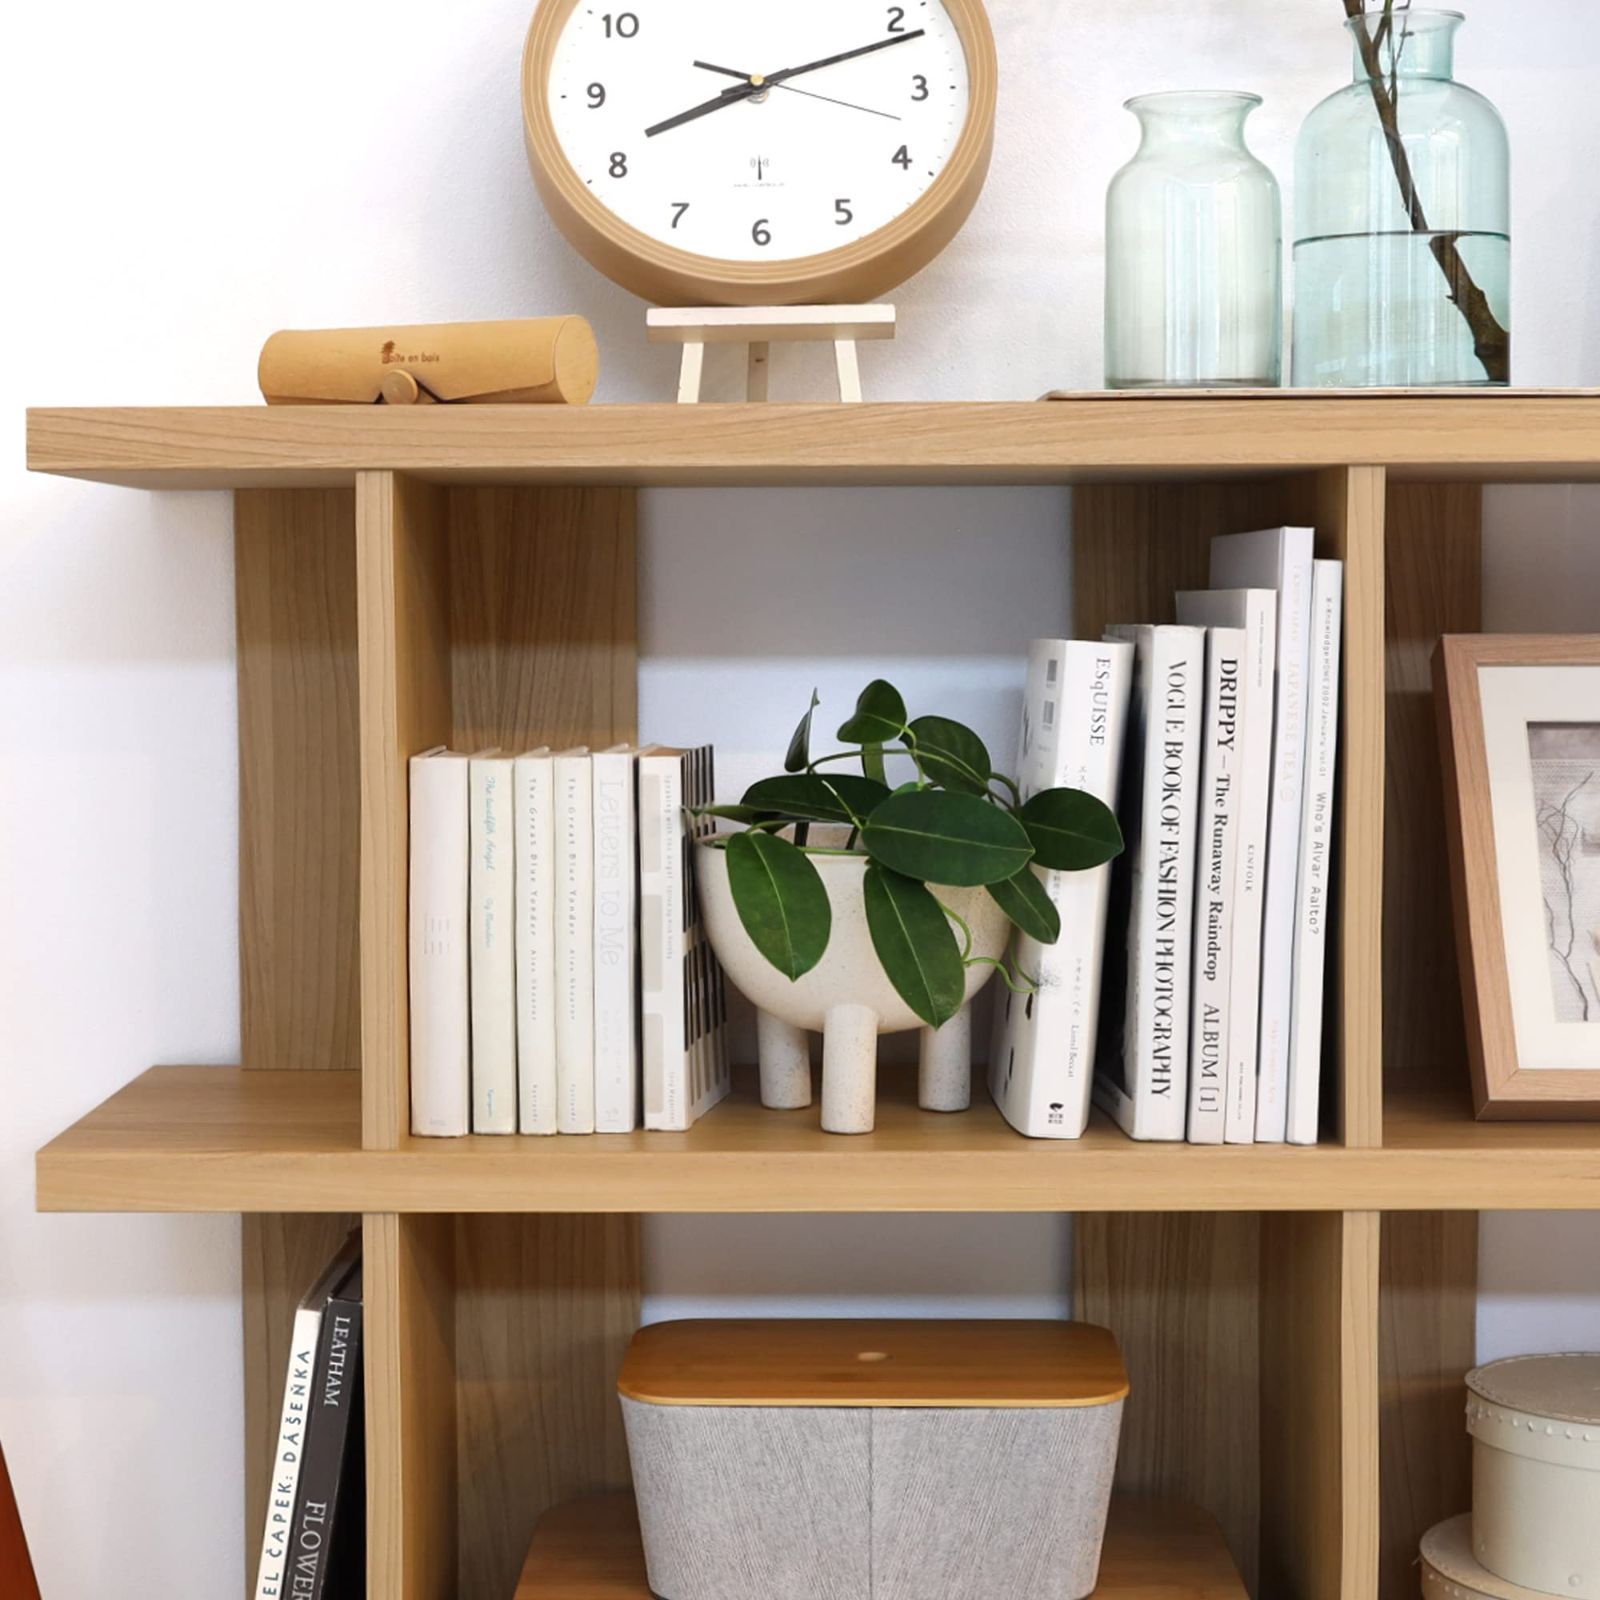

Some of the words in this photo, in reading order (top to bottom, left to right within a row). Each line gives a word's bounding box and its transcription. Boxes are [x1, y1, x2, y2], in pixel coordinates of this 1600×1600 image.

[602, 12, 640, 38] 10
[886, 7, 905, 33] 2
[587, 82, 606, 109] 9
[911, 75, 929, 101] 3
[608, 152, 628, 178] 8
[891, 145, 913, 170] 4
[671, 203, 690, 228] 7
[834, 199, 853, 225] 5
[751, 218, 771, 246] 6
[1089, 658, 1111, 746] ESqUISSE
[1165, 660, 1187, 733] VOGUE
[1217, 658, 1238, 752] DRIPPY
[1286, 662, 1300, 743] JAPANESE
[1321, 685, 1329, 707] 2002
[1162, 741, 1184, 802] BOOK
[1283, 750, 1296, 781] TEA
[485, 776, 496, 795] The
[529, 778, 537, 799] The
[568, 778, 576, 799] The
[1215, 774, 1231, 807] The
[529, 807, 538, 846] Great
[568, 807, 576, 845] Great
[599, 779, 624, 879] Letters
[1160, 804, 1181, 836] OF
[1314, 791, 1327, 833] Who's
[482, 839, 496, 872] Angel
[529, 853, 538, 882] Blue
[568, 853, 576, 882] Blue
[1207, 813, 1229, 895] Runaway
[1245, 844, 1255, 892] KINFOLK
[1312, 841, 1324, 878] Alvar
[599, 890, 621, 917] to
[1157, 840, 1180, 931] FASHION
[529, 890, 538, 936] Yonder
[568, 890, 577, 935] Yonder
[1309, 886, 1321, 934] Aalto?
[599, 924, 625, 966] Me
[1203, 901, 1224, 981] Raindrop
[1151, 938, 1176, 1099] PHOTOGRAPHY
[1201, 1003, 1220, 1078] ALBUM
[1199, 1087, 1219, 1112] [1]
[324, 1315, 351, 1408] LEATHAM
[265, 1474, 293, 1559] ČAPEK:
[282, 1350, 311, 1463] DÁŠEŇKA
